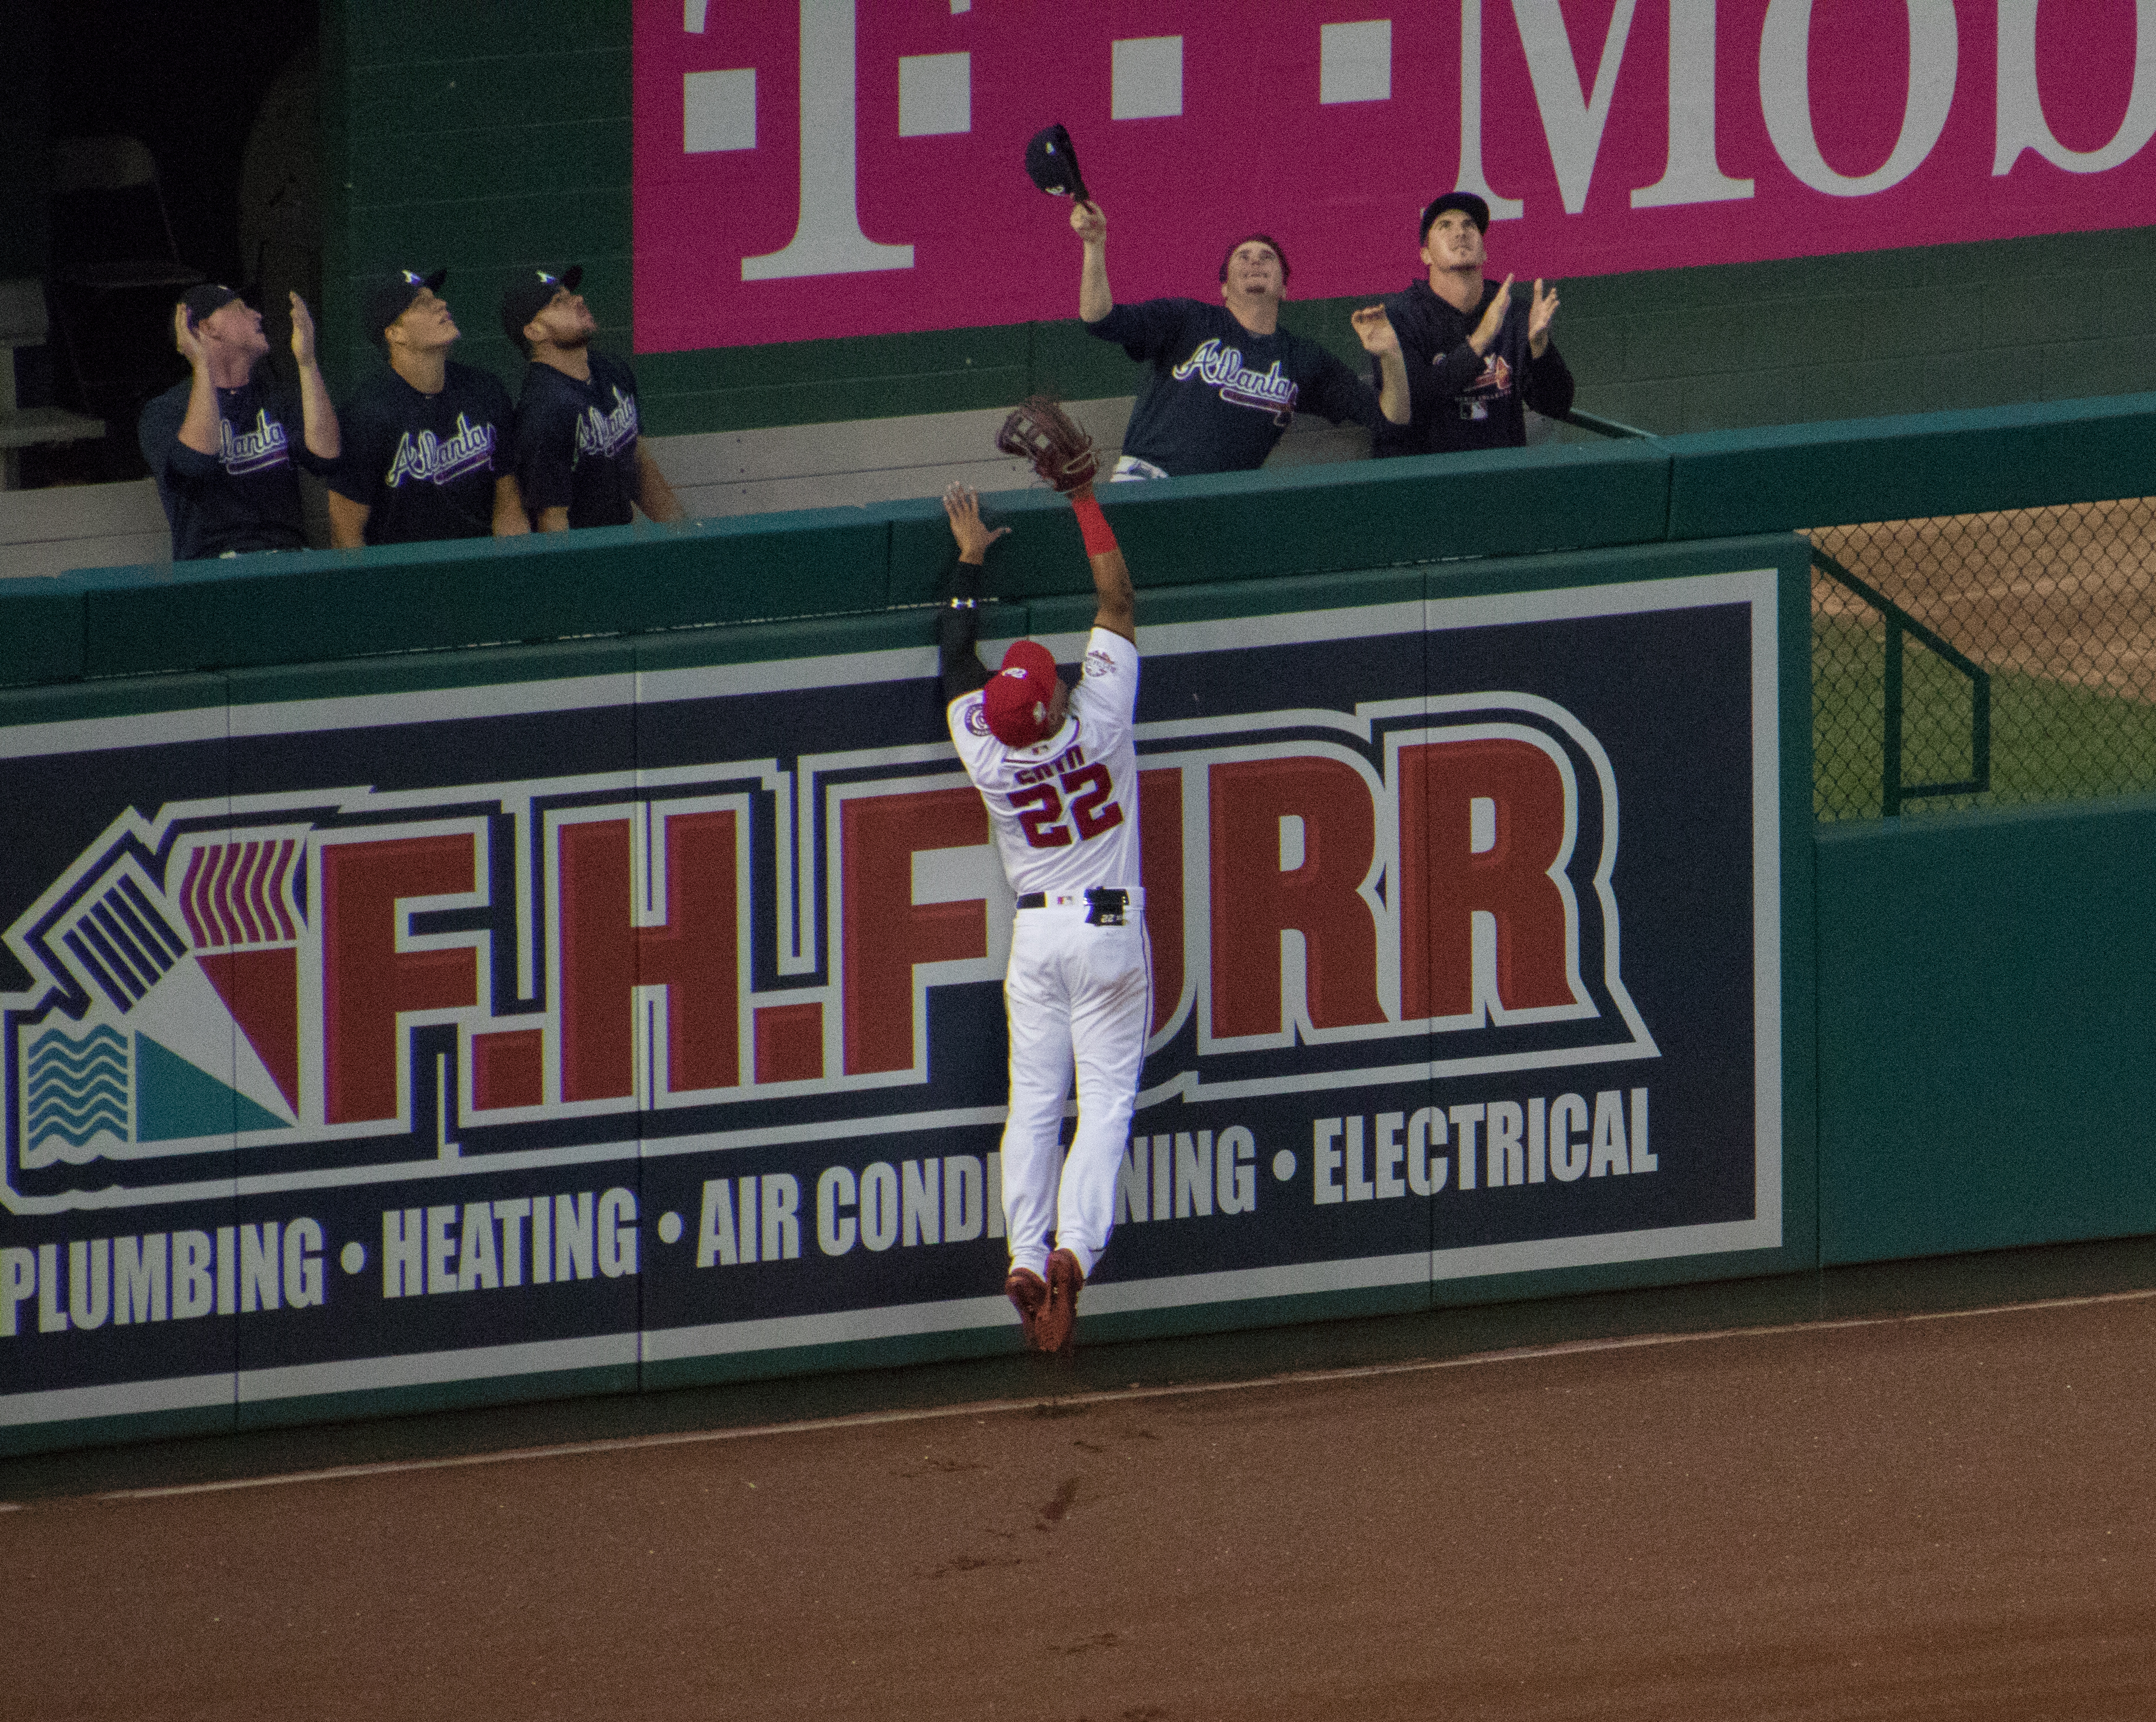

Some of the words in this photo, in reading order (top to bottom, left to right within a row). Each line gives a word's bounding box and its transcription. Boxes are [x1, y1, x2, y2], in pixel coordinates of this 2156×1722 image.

[1172, 338, 1293, 403] Atlanta
[386, 412, 493, 487] Atlanta
[1007, 762, 1124, 848] 22
[0, 1217, 325, 1336] PLUMBING
[383, 1186, 640, 1298] HEATING
[696, 1173, 800, 1267] AIR
[817, 1125, 1256, 1256] CONDINING
[1314, 1087, 1658, 1205] ELECTRICAL
